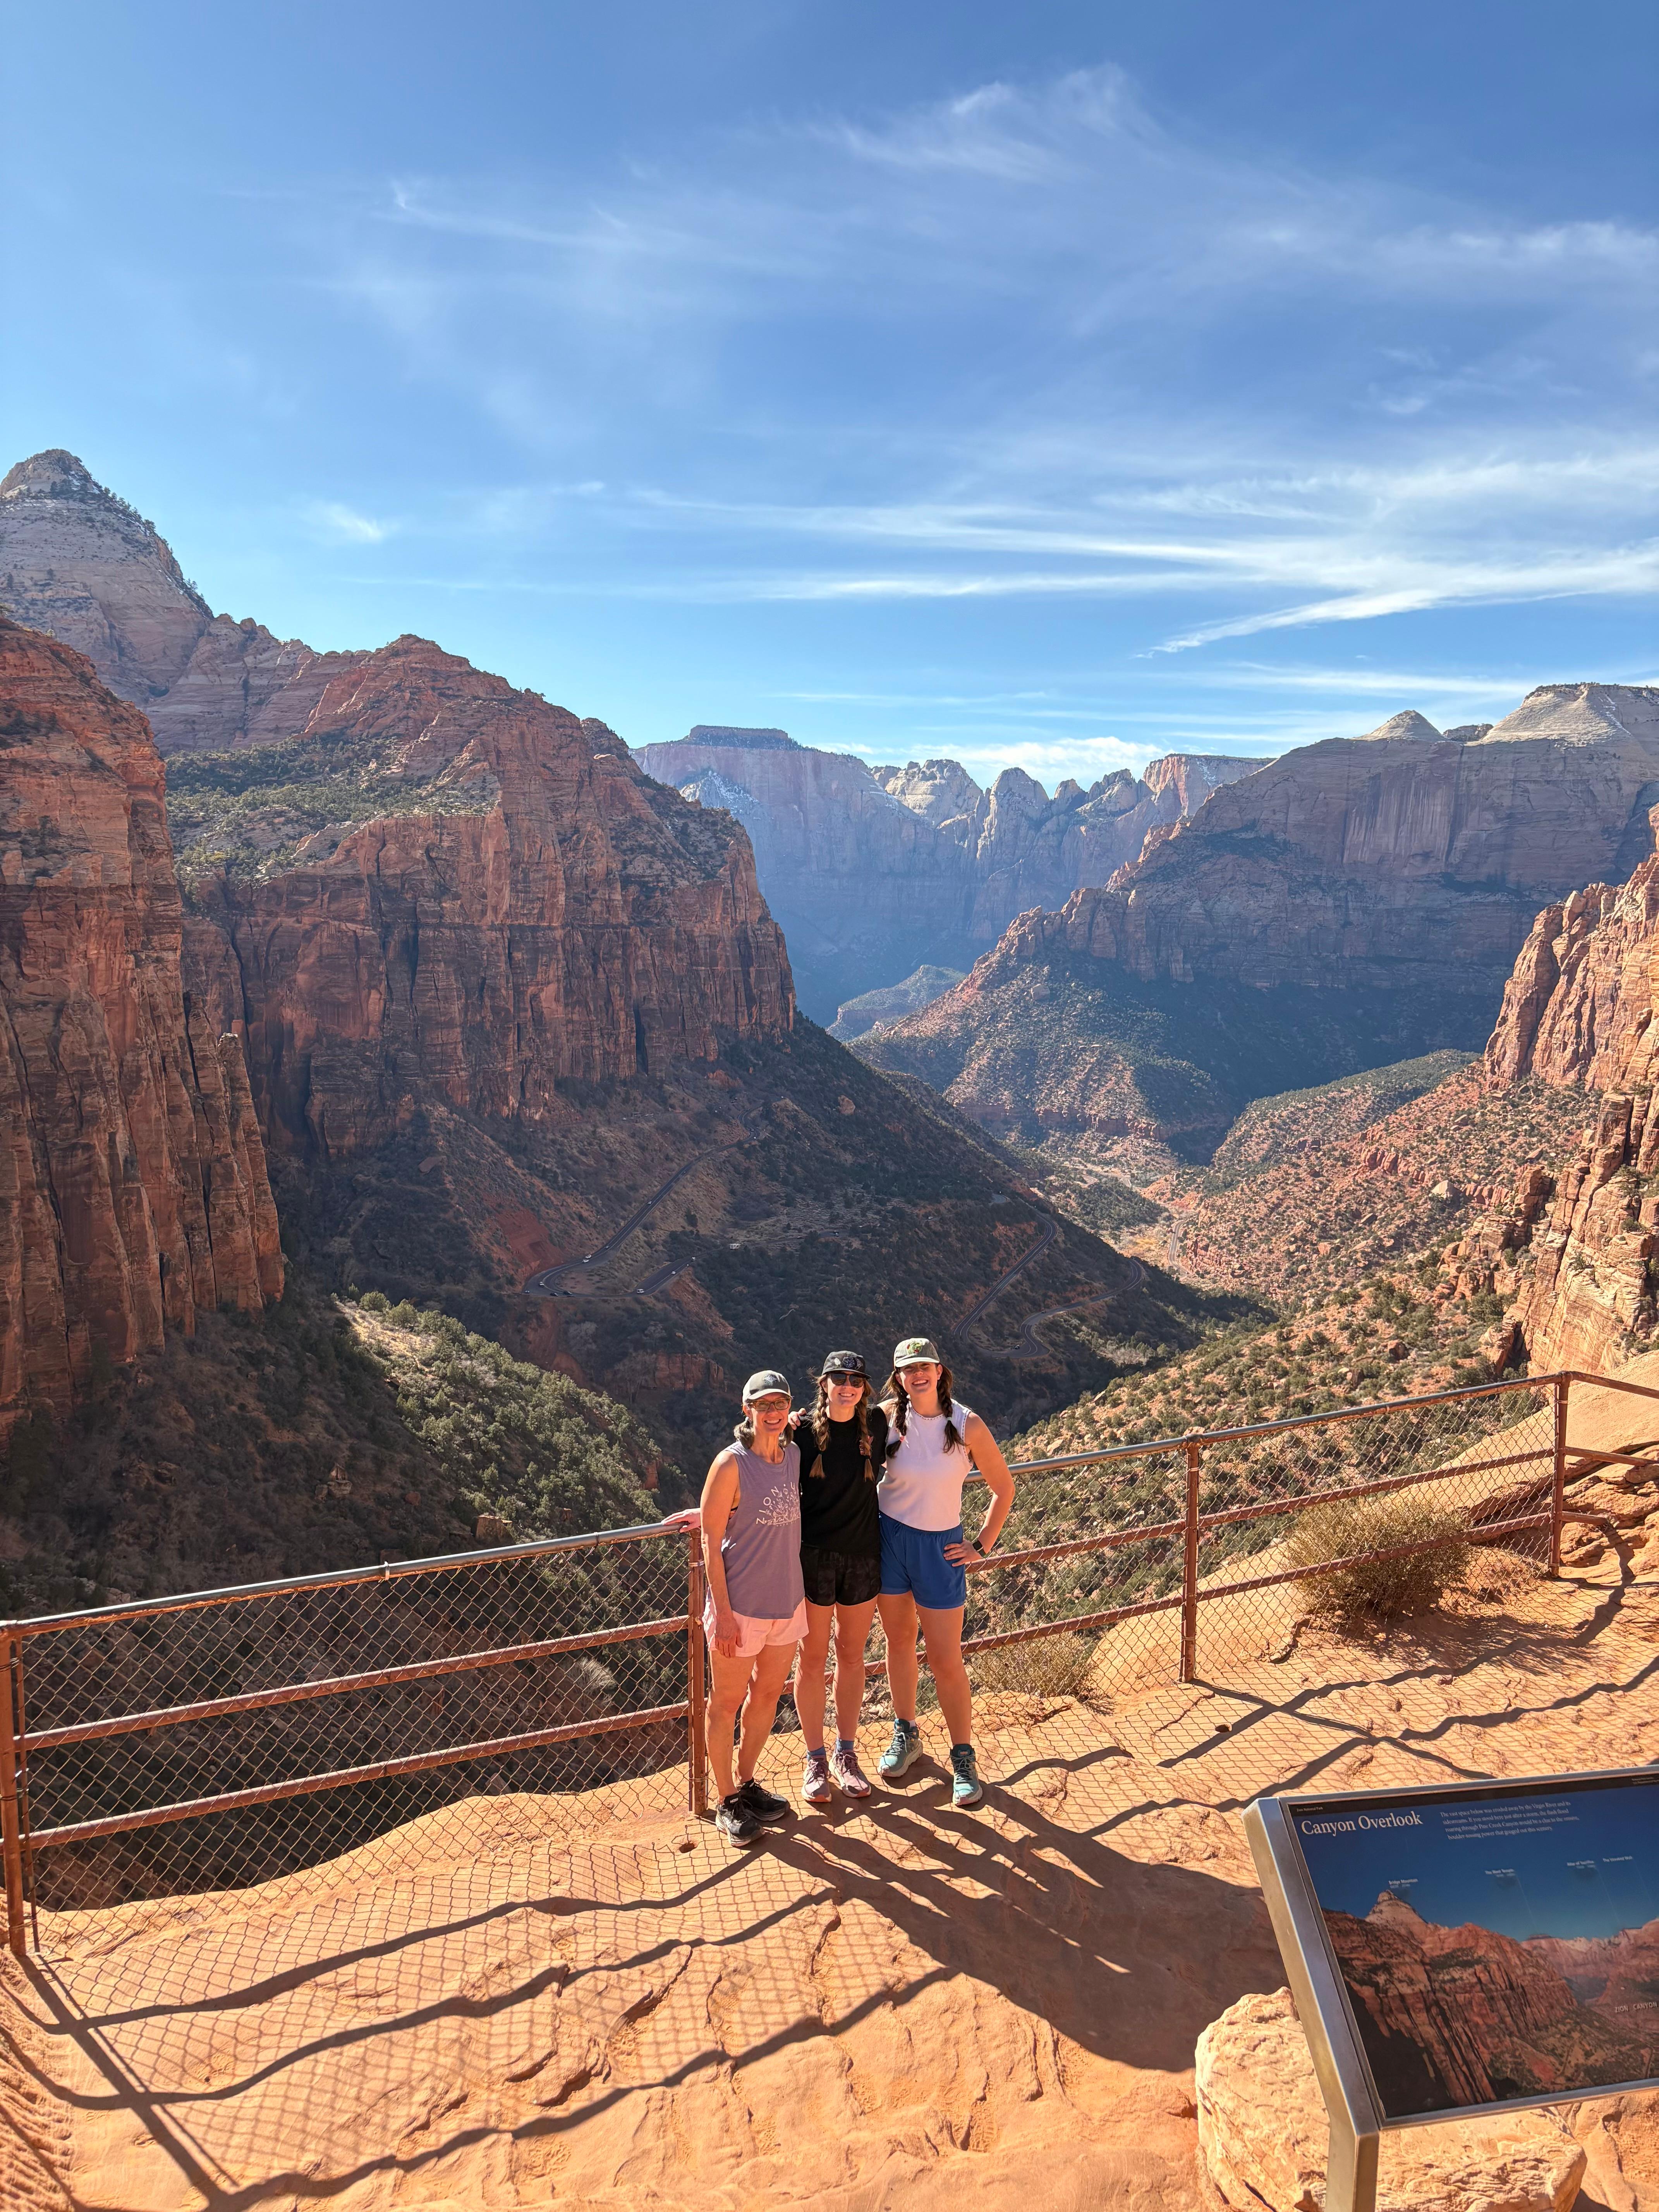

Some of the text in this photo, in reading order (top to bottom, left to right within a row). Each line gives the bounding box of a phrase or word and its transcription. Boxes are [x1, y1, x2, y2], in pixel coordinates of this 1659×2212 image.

[756, 1486, 779, 1524] ZION
[1301, 1811, 1424, 1836] Canyon Overlook
[1633, 2001, 1657, 2010] CANYON
